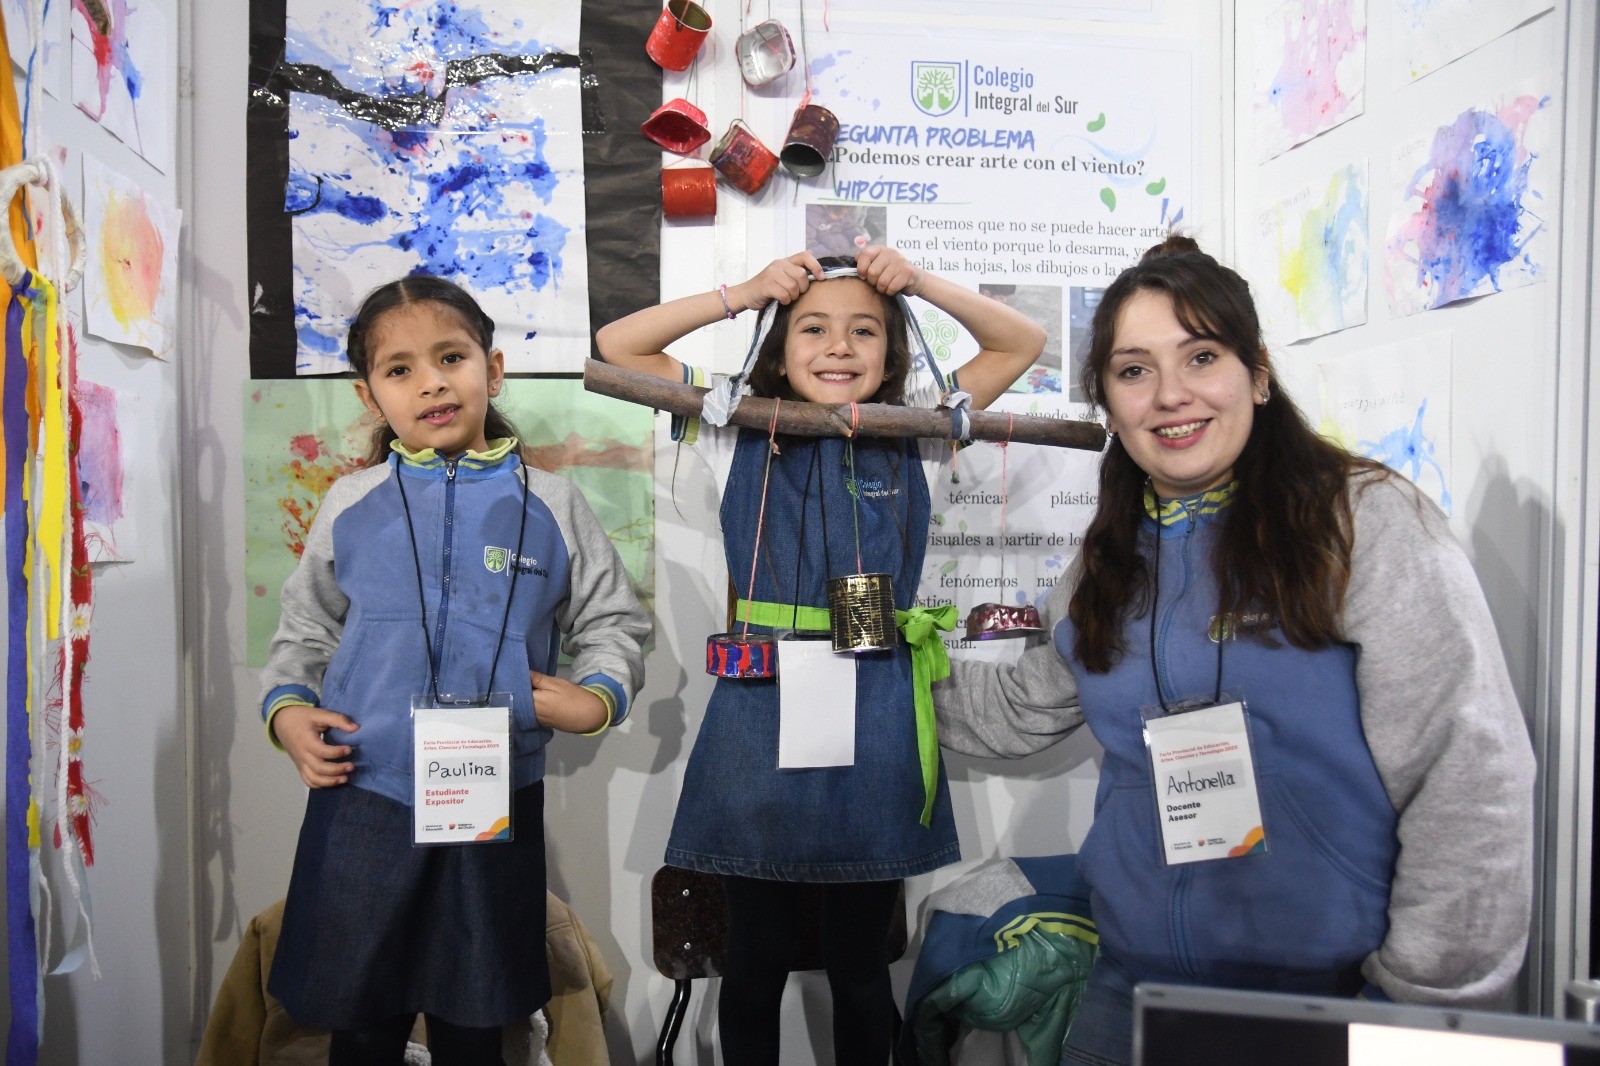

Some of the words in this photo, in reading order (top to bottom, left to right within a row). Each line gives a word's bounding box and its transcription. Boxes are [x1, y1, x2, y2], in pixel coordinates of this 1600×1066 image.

[974, 65, 1034, 92] Colegio
[975, 91, 1032, 115] Integral
[1036, 101, 1050, 113] del
[1054, 95, 1078, 114] Sur
[835, 124, 918, 147] EGUNTA
[926, 126, 1035, 151] PROBLEMA
[926, 156, 975, 168] crear
[980, 154, 1018, 169] arte
[1023, 158, 1055, 170] con
[1061, 156, 1076, 171] el
[1080, 157, 1145, 176] viento?
[836, 175, 939, 202] HIPÓTESIS
[907, 215, 974, 230] Creemos
[978, 220, 1004, 234] que
[1009, 221, 1027, 232] no
[1031, 222, 1047, 233] se
[1051, 220, 1094, 236] puede
[1098, 222, 1136, 237] hacer
[1140, 225, 1168, 238] arte
[896, 239, 921, 250] con
[926, 236, 938, 250] el
[942, 238, 988, 252] viento
[993, 240, 1043, 255] porque
[1049, 240, 1061, 253] lo
[1065, 241, 1129, 258] desarma,
[939, 258, 959, 272] las
[964, 258, 1007, 275] hojas,
[1012, 259, 1032, 273] los
[1036, 259, 1087, 277] dibujos
[1092, 266, 1100, 276] o
[1104, 263, 1116, 276] la
[950, 491, 1008, 505] técnicas
[986, 536, 995, 547] a
[1047, 532, 1064, 547] de
[1069, 533, 1081, 547] lo
[511, 553, 537, 566] Clegio
[940, 574, 1018, 588] fenómenos
[428, 761, 497, 778] Paulina
[1167, 770, 1236, 796] Antonella
[425, 788, 470, 797] Estudiante
[425, 798, 465, 807] Expositor
[1166, 801, 1201, 812] Docente
[1168, 813, 1197, 822] Asesor
